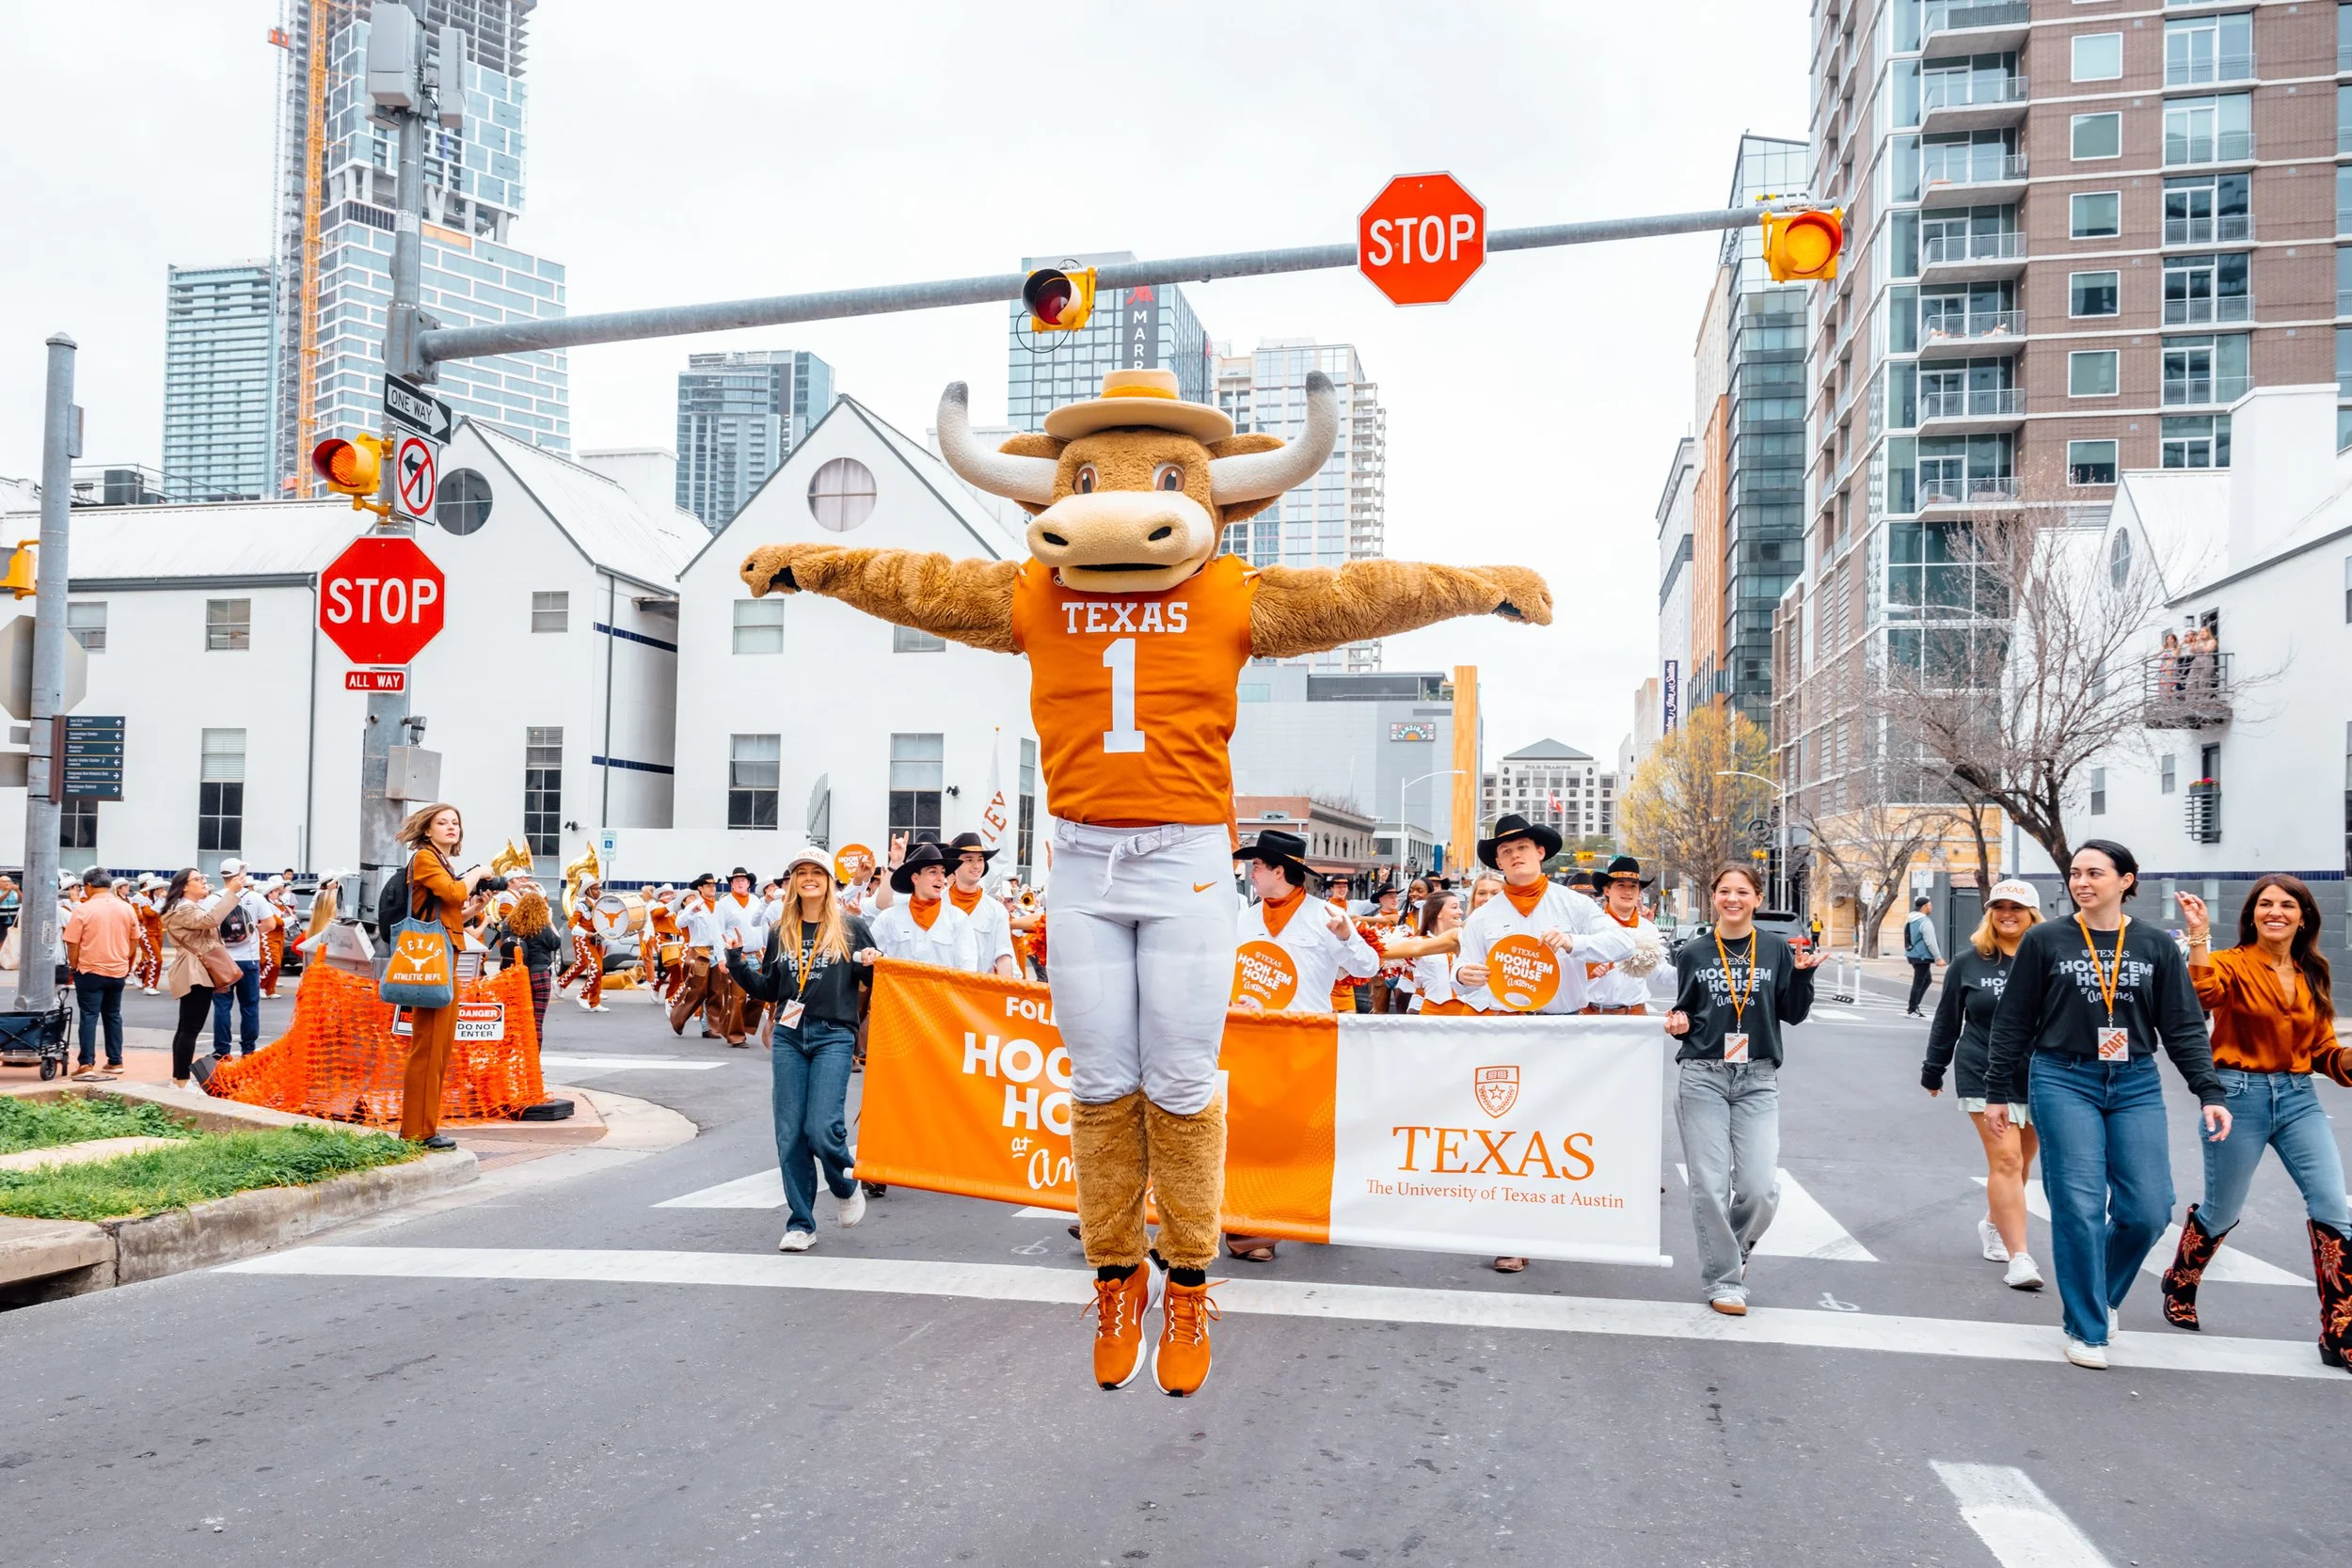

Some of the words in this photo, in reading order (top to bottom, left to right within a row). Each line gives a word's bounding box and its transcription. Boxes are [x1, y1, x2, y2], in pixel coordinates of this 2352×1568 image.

[1368, 214, 1476, 266] STOP
[391, 389, 410, 413] ONE
[414, 400, 433, 422] WAY
[326, 578, 437, 624] STOP
[1061, 602, 1188, 633] TEXAS
[349, 674, 370, 688] ALL
[377, 675, 400, 688] WAY
[1103, 638, 1145, 752] 1
[798, 850, 826, 861] TEXAS
[1994, 886, 2026, 895] TEXAS
[396, 939, 442, 958] TEXAS
[1518, 947, 1540, 958] TEXAS
[2094, 949, 2130, 958] TEXS
[1236, 953, 1272, 975] HOOK
[1273, 969, 1293, 986] 'EM
[1261, 953, 1282, 968] TEXAS
[1495, 951, 1531, 969] HOOK
[1533, 960, 1553, 974] 'EM
[2122, 960, 2153, 976] 'EM
[393, 972, 422, 981] ATHLETIC
[424, 973, 441, 981] DEPT.
[1242, 966, 1280, 990] HOUSE
[1502, 963, 1543, 982] HOUSE
[2076, 972, 2140, 987] HOUSE
[1708, 979, 1760, 992] HOUSE
[458, 1008, 498, 1018] DANGER
[2098, 1031, 2128, 1059] STAFF
[1011, 1136, 1033, 1159] at
[1392, 1126, 1595, 1181] TEXAS
[1366, 1179, 1393, 1196] The
[1397, 1181, 1477, 1203] University
[1480, 1185, 1497, 1201] of
[1502, 1186, 1546, 1204] Texas
[1550, 1191, 1566, 1205] at
[1569, 1192, 1625, 1210] Austin
